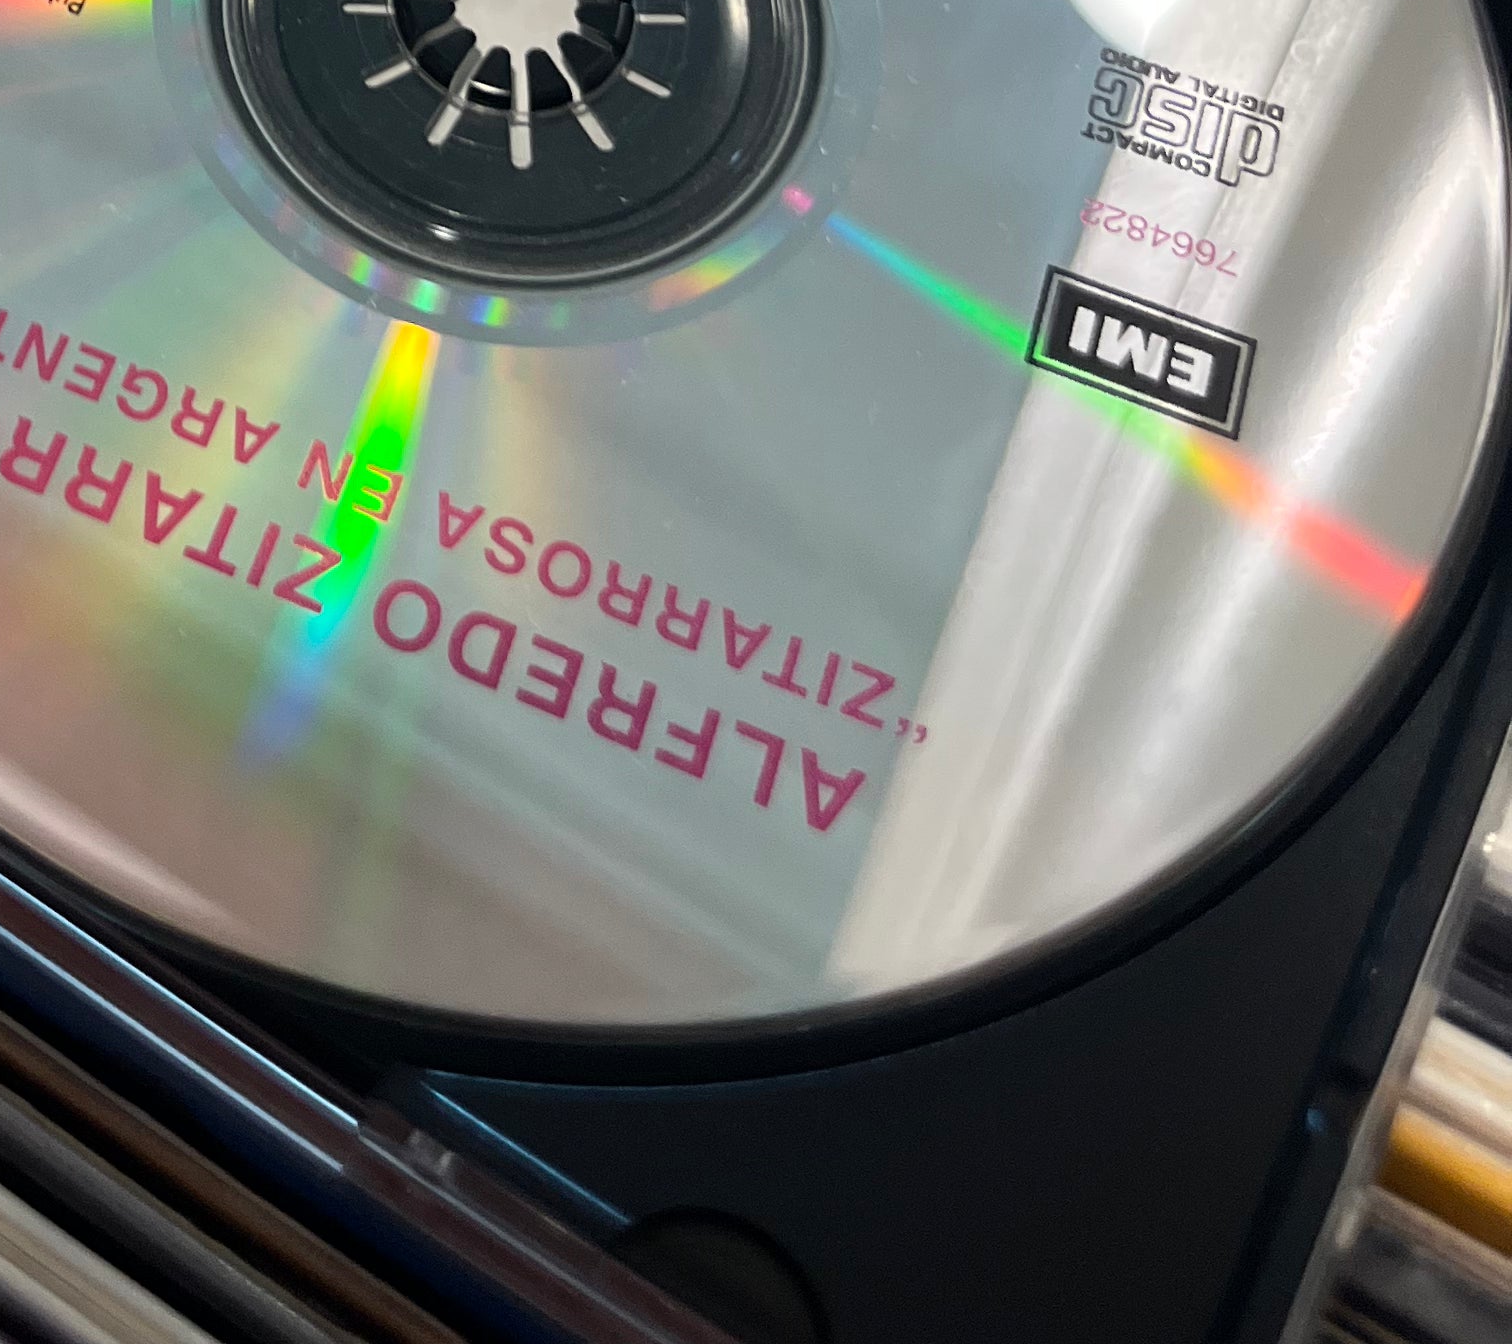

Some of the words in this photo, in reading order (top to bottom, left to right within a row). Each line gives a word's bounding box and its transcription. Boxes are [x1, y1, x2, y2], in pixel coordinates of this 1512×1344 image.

[1100, 47, 1181, 84] AUDIO
[1188, 74, 1285, 122] DIGITAL
[1080, 121, 1211, 177] COMPACT
[1088, 65, 1281, 187] disc
[1081, 197, 1237, 277] 7664822
[296, 438, 404, 522] EN
[371, 577, 866, 832] ALFREDO
